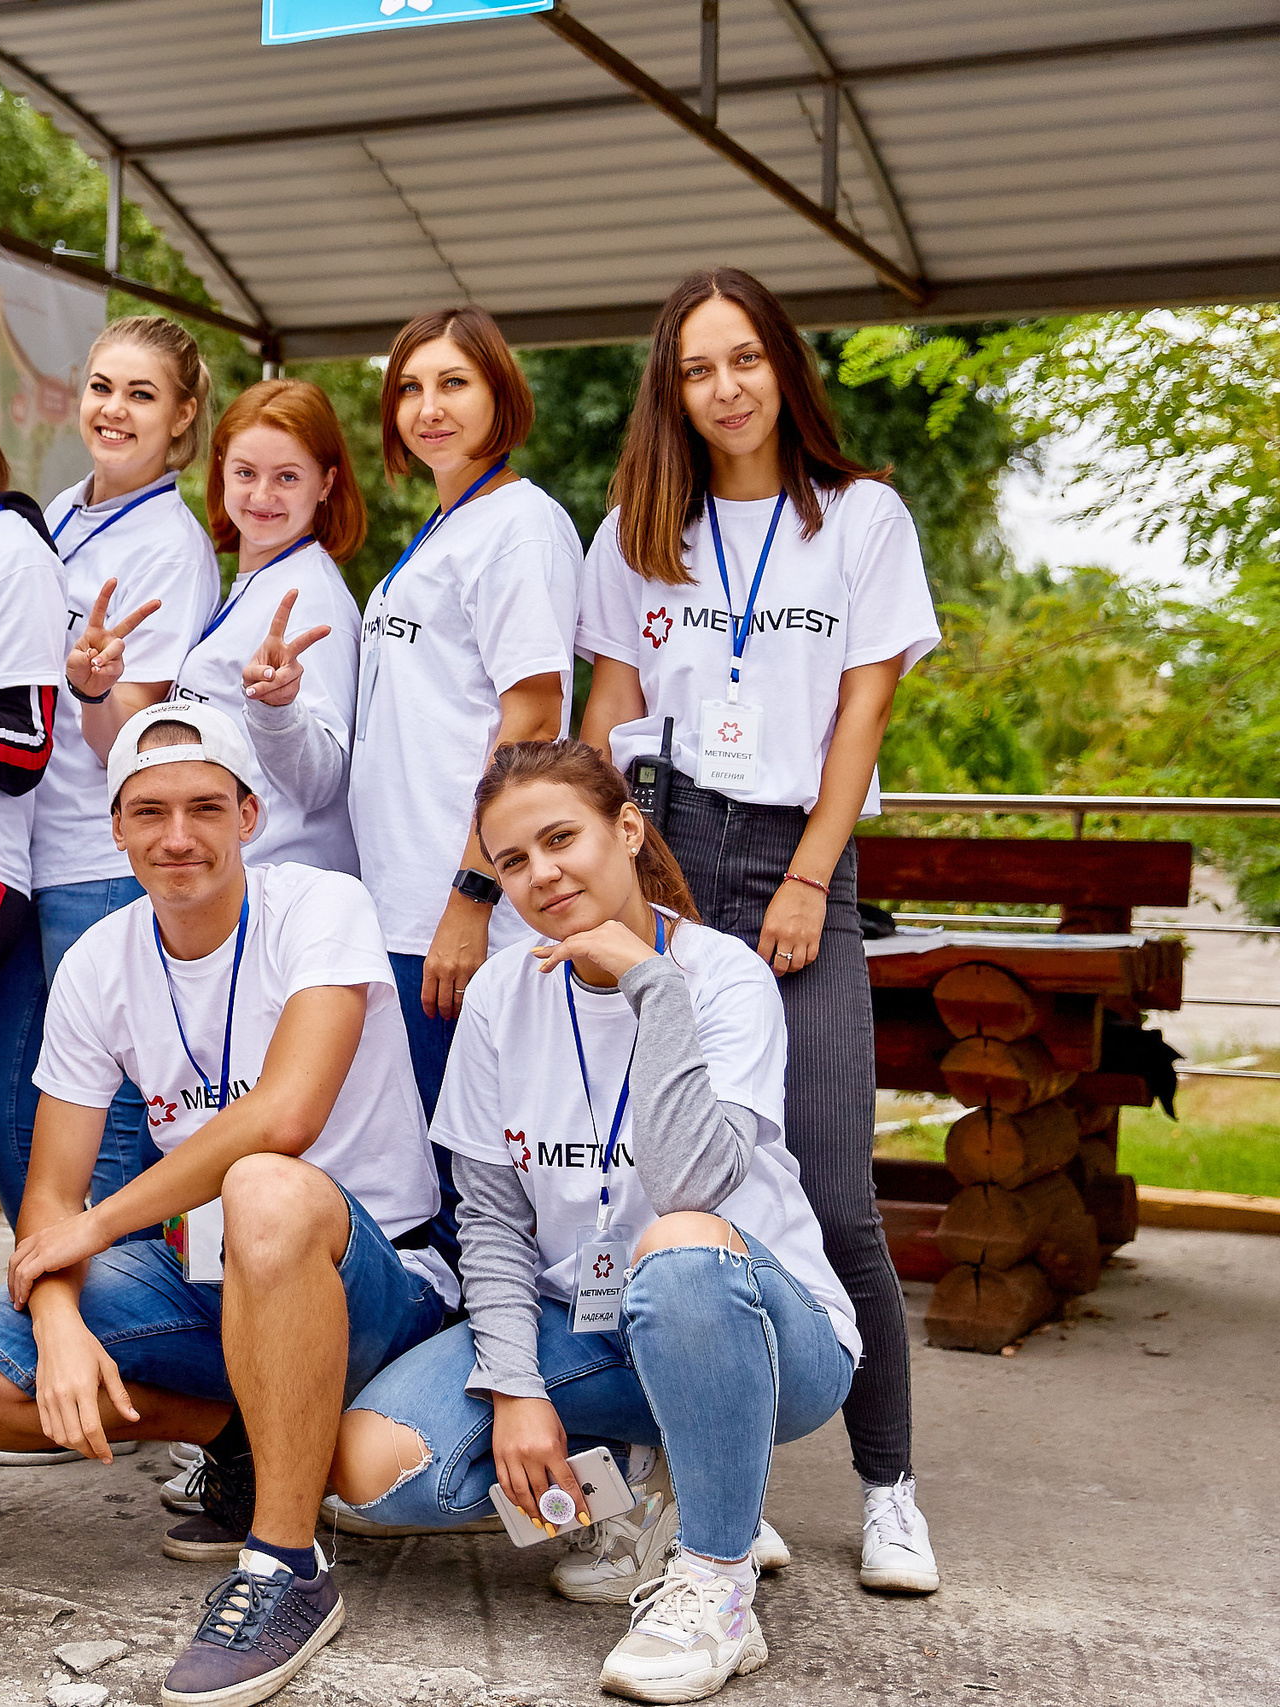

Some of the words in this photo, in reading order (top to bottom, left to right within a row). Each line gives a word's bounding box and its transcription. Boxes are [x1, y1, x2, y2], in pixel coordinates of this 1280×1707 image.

[683, 606, 839, 638] METNVEST
[704, 749, 753, 760] METINVEST
[711, 770, 745, 780] ЕВГЕНИЯ
[580, 1287, 621, 1297] METINVEST
[581, 1312, 614, 1321] НАДЕЖДА
